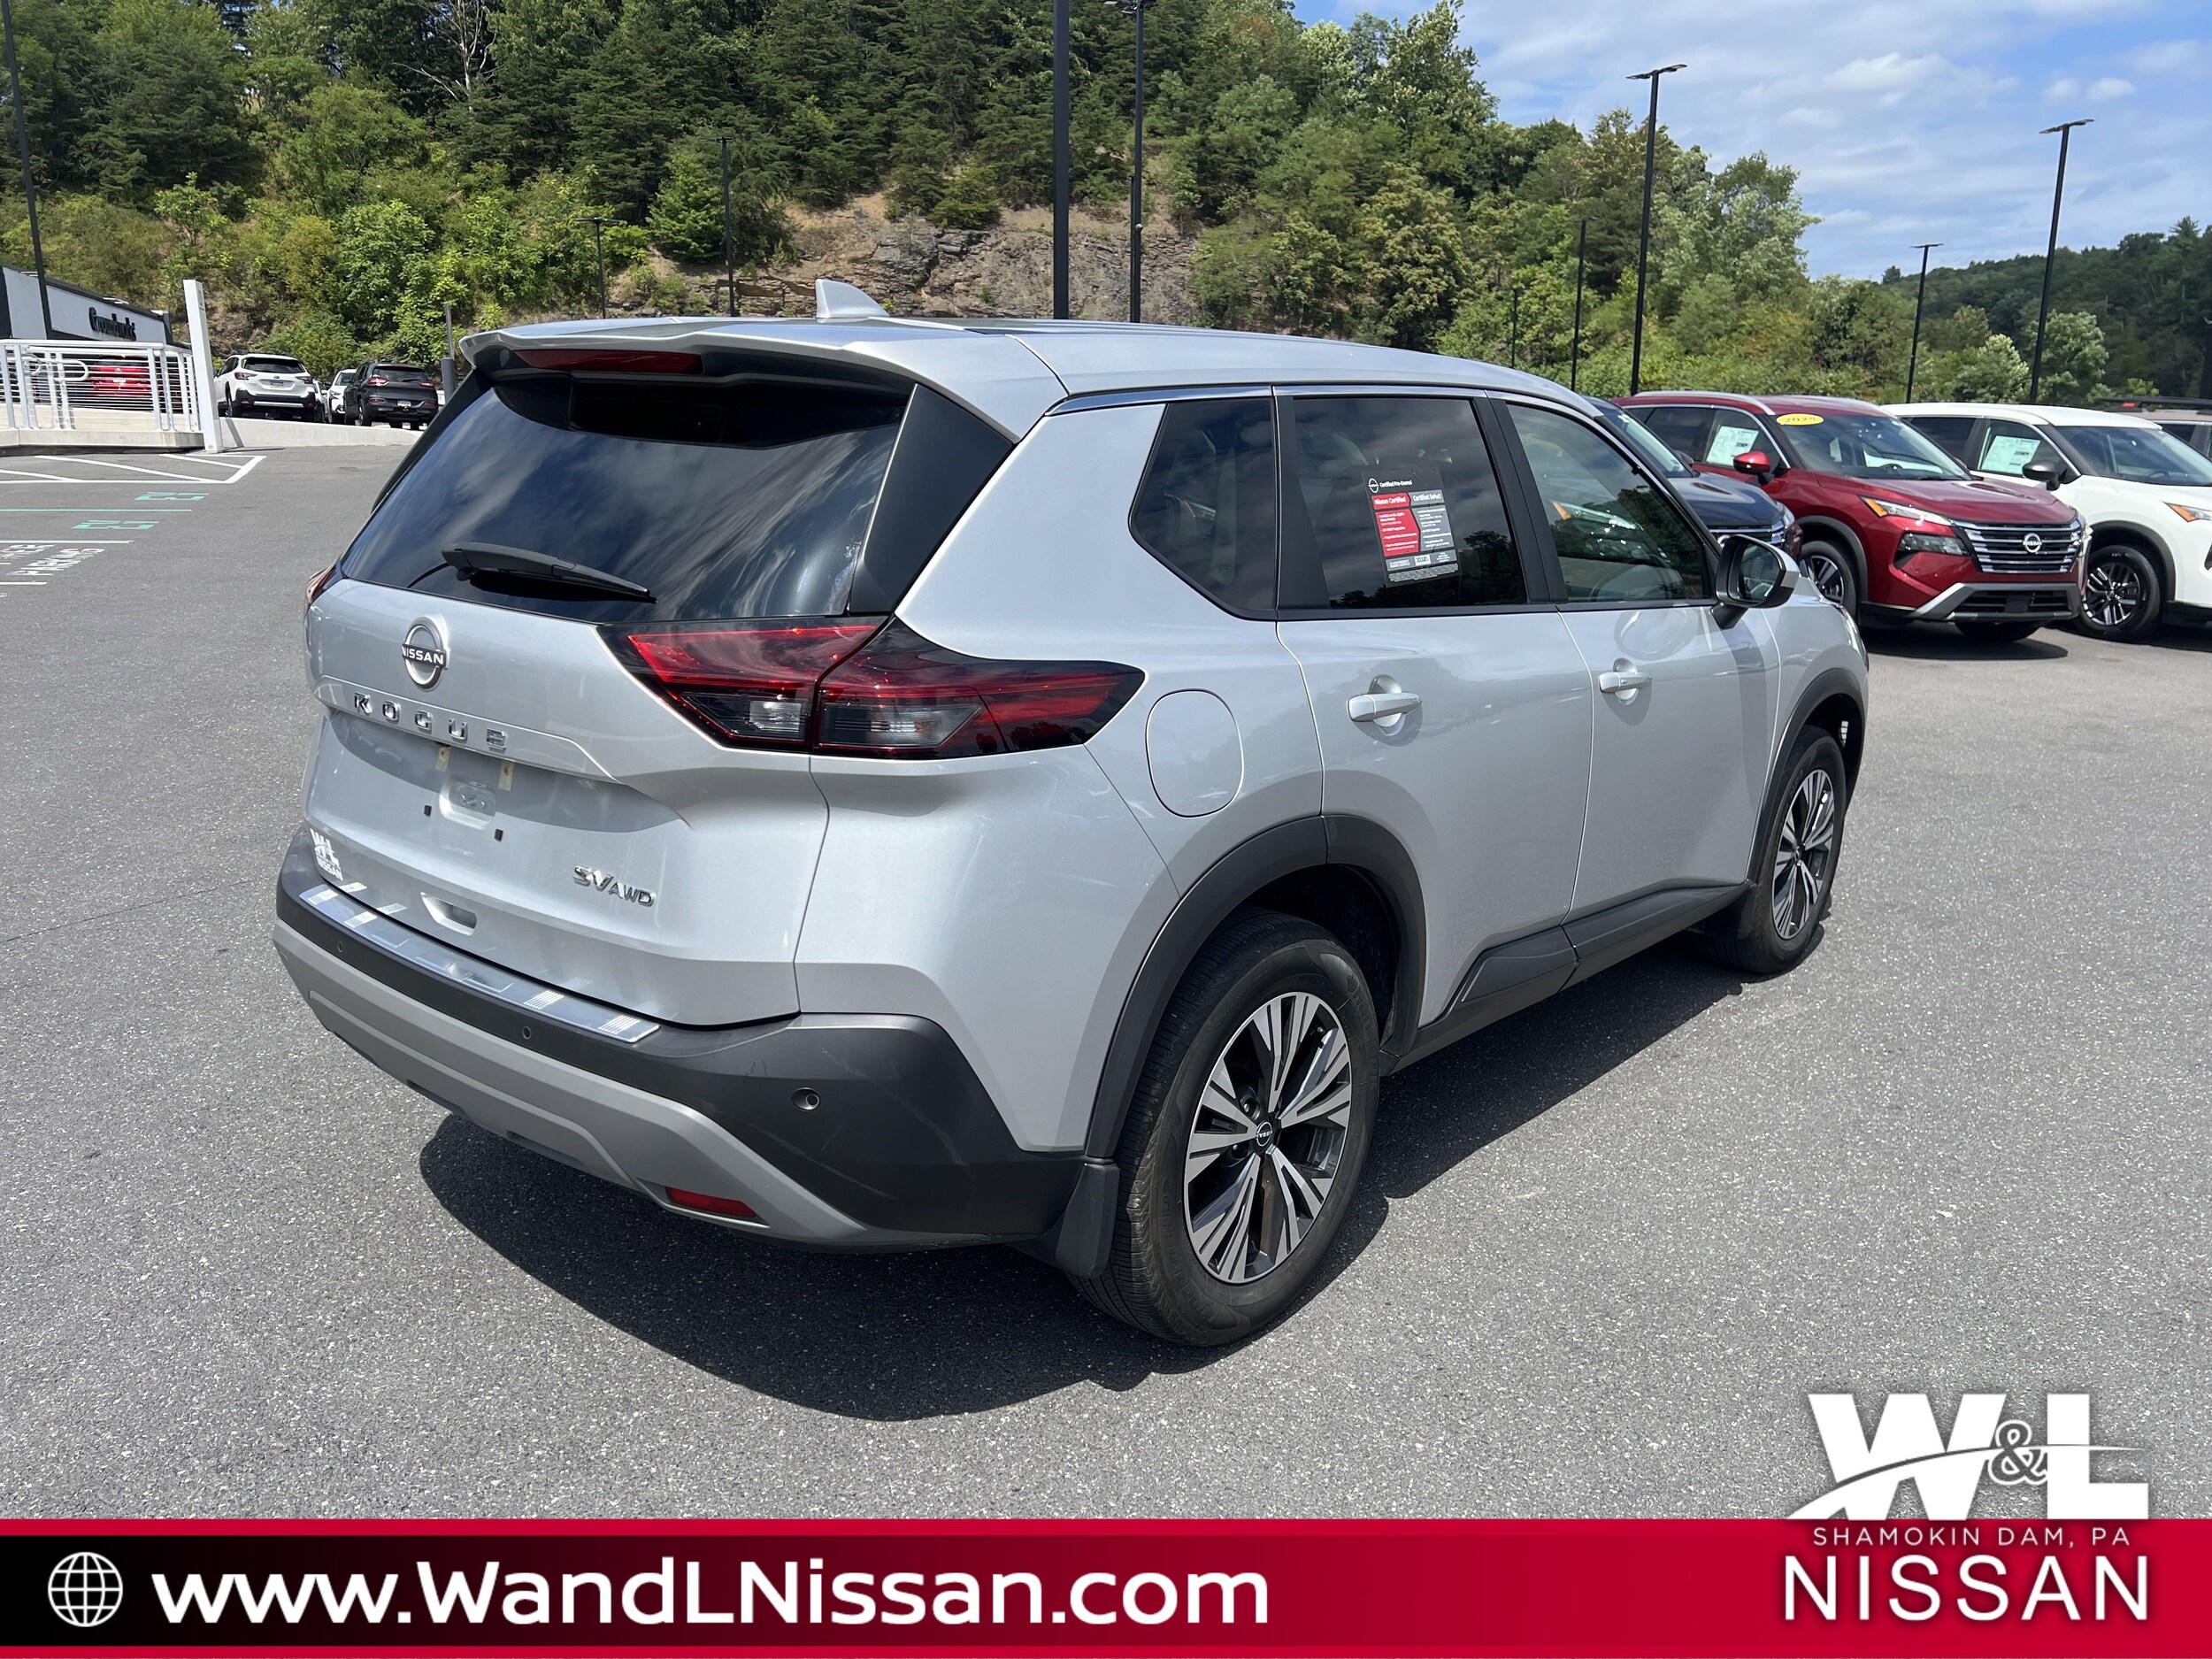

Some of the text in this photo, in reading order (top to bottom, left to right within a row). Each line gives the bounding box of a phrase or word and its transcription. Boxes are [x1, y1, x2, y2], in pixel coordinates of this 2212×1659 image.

[402, 646, 444, 664] NISSAN
[354, 692, 508, 748] ROGUE
[573, 865, 657, 907] SV AWD
